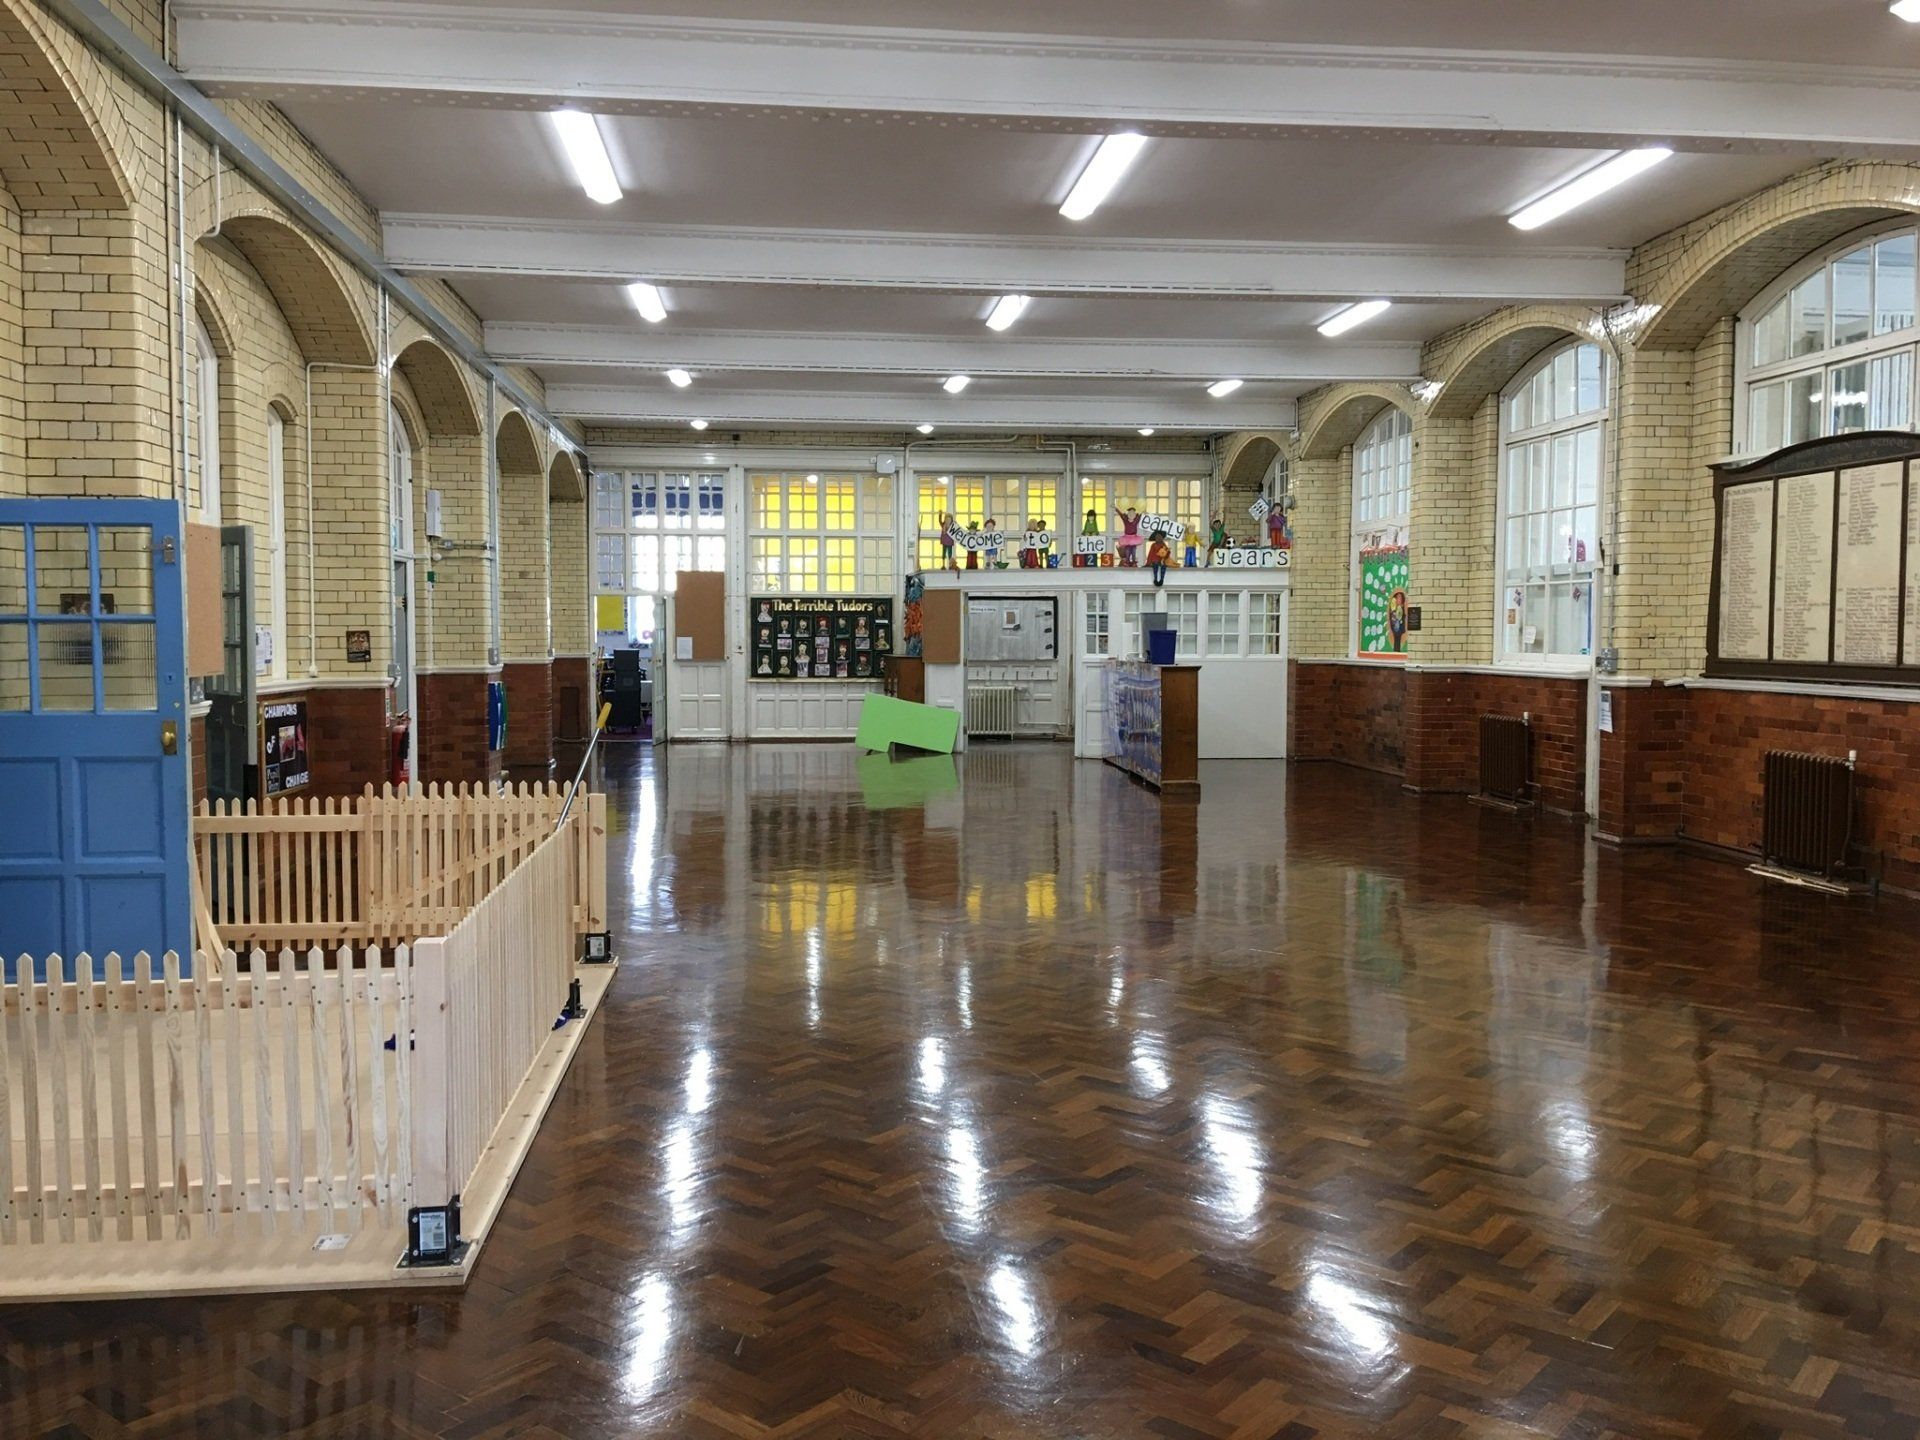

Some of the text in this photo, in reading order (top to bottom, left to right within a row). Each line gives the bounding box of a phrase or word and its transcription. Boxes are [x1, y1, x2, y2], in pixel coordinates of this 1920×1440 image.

[1029, 532, 1050, 546] to
[1077, 537, 1105, 552] the
[1216, 550, 1289, 566] years
[1087, 554, 1094, 566] 2
[1101, 554, 1111, 566] 3
[772, 599, 873, 611] The Terrible Tudors
[266, 735, 276, 754] OF
[285, 771, 310, 788] CHANGE
